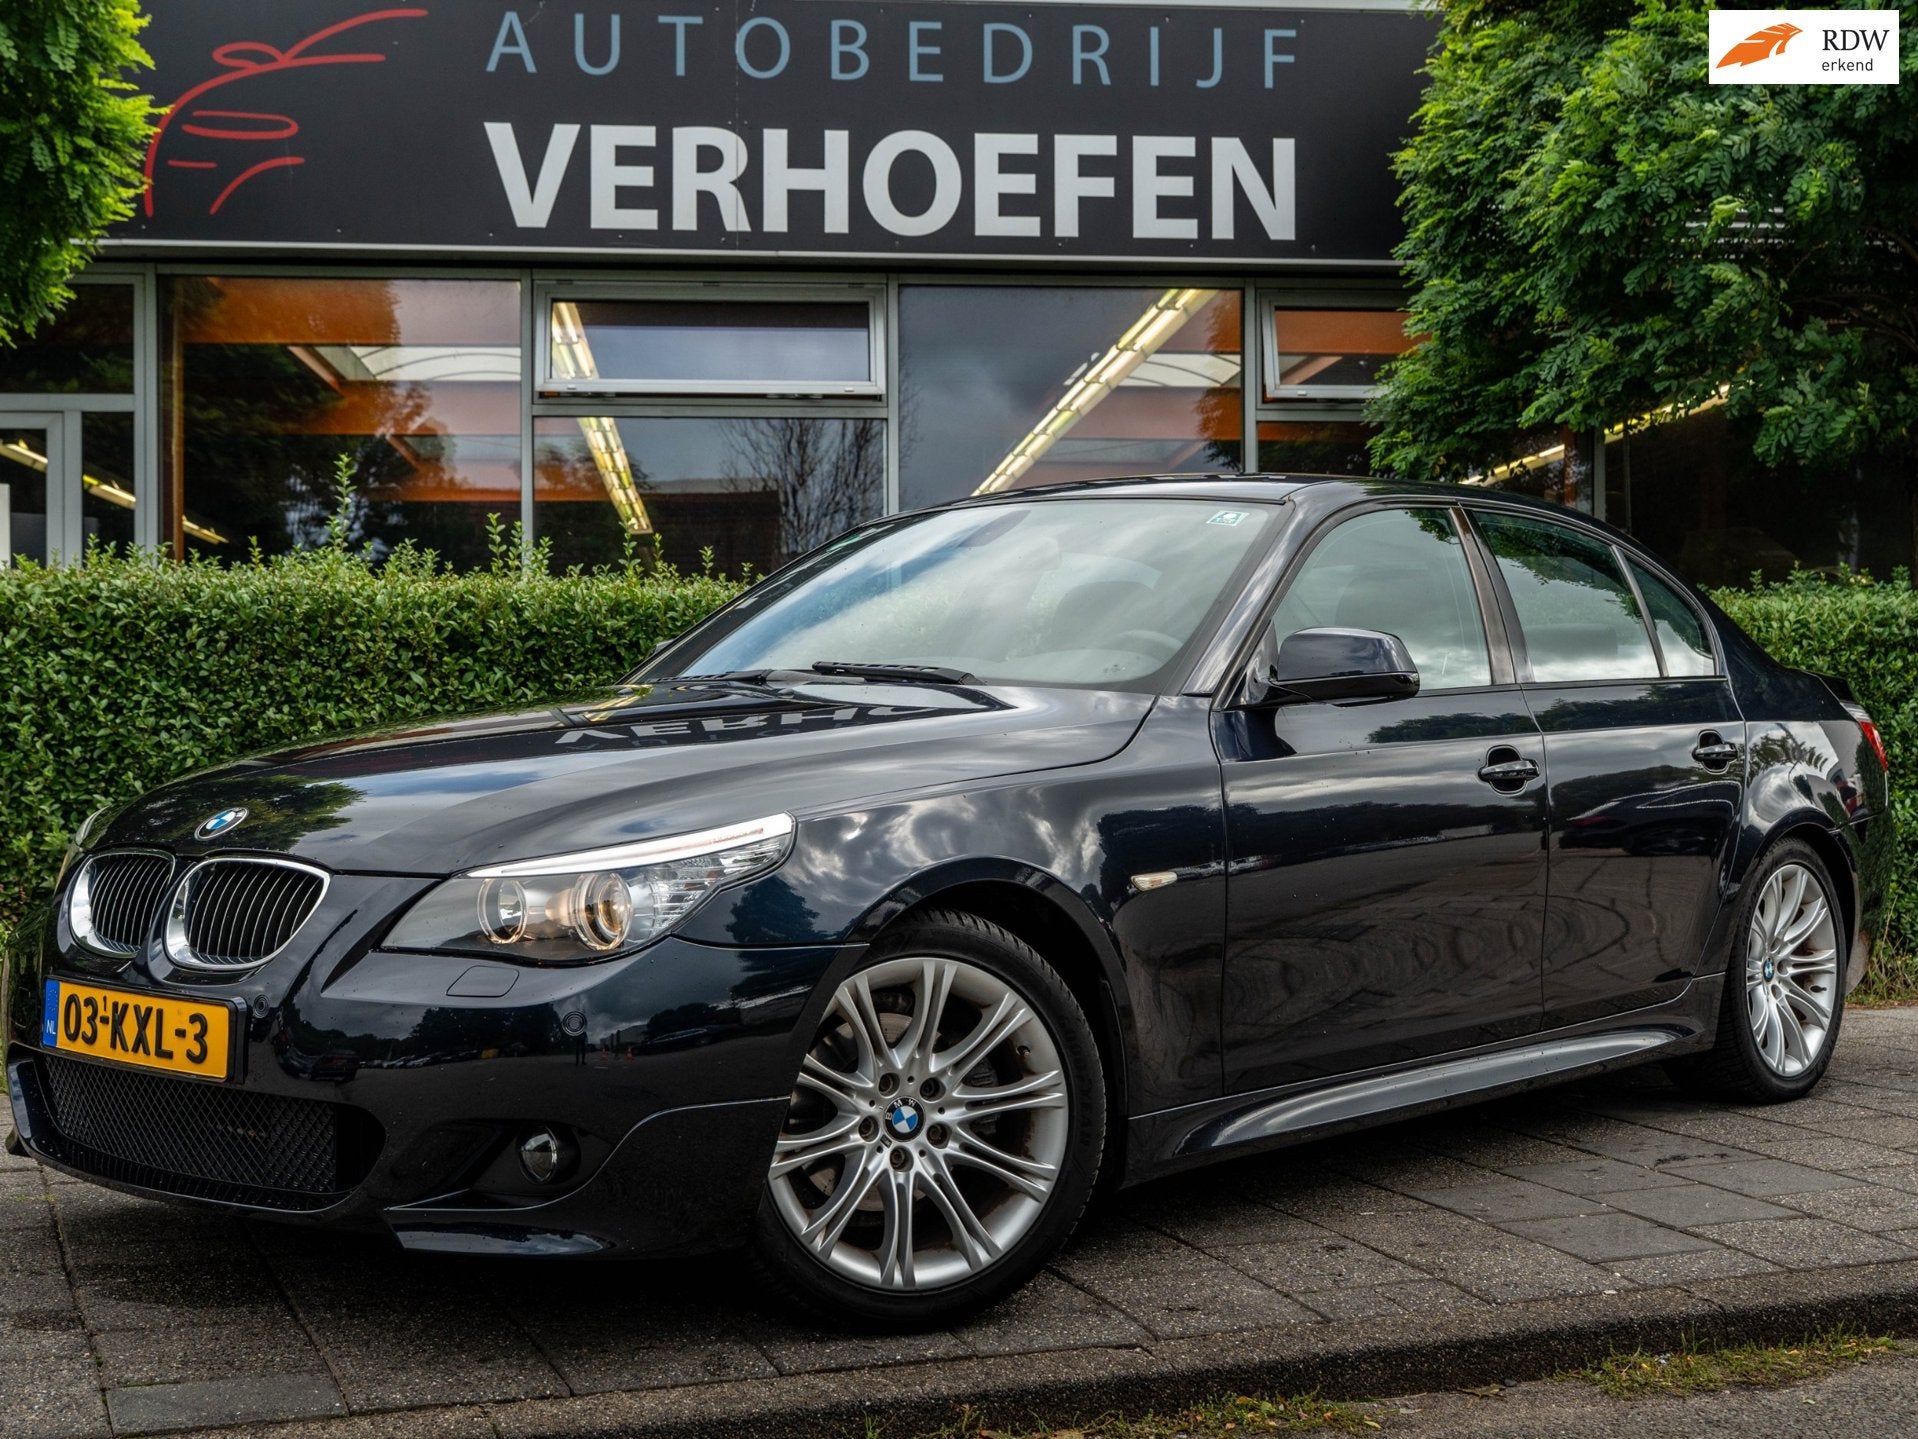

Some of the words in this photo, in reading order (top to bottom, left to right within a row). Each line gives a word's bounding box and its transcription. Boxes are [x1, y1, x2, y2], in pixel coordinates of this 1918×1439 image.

[486, 11, 1297, 89] AUTOBEDRIJF
[484, 121, 1296, 241] VERHOEFEN
[46, 1019, 56, 1035] NL
[64, 993, 208, 1064] 03-KXL-3
[885, 1099, 917, 1120] BMW
